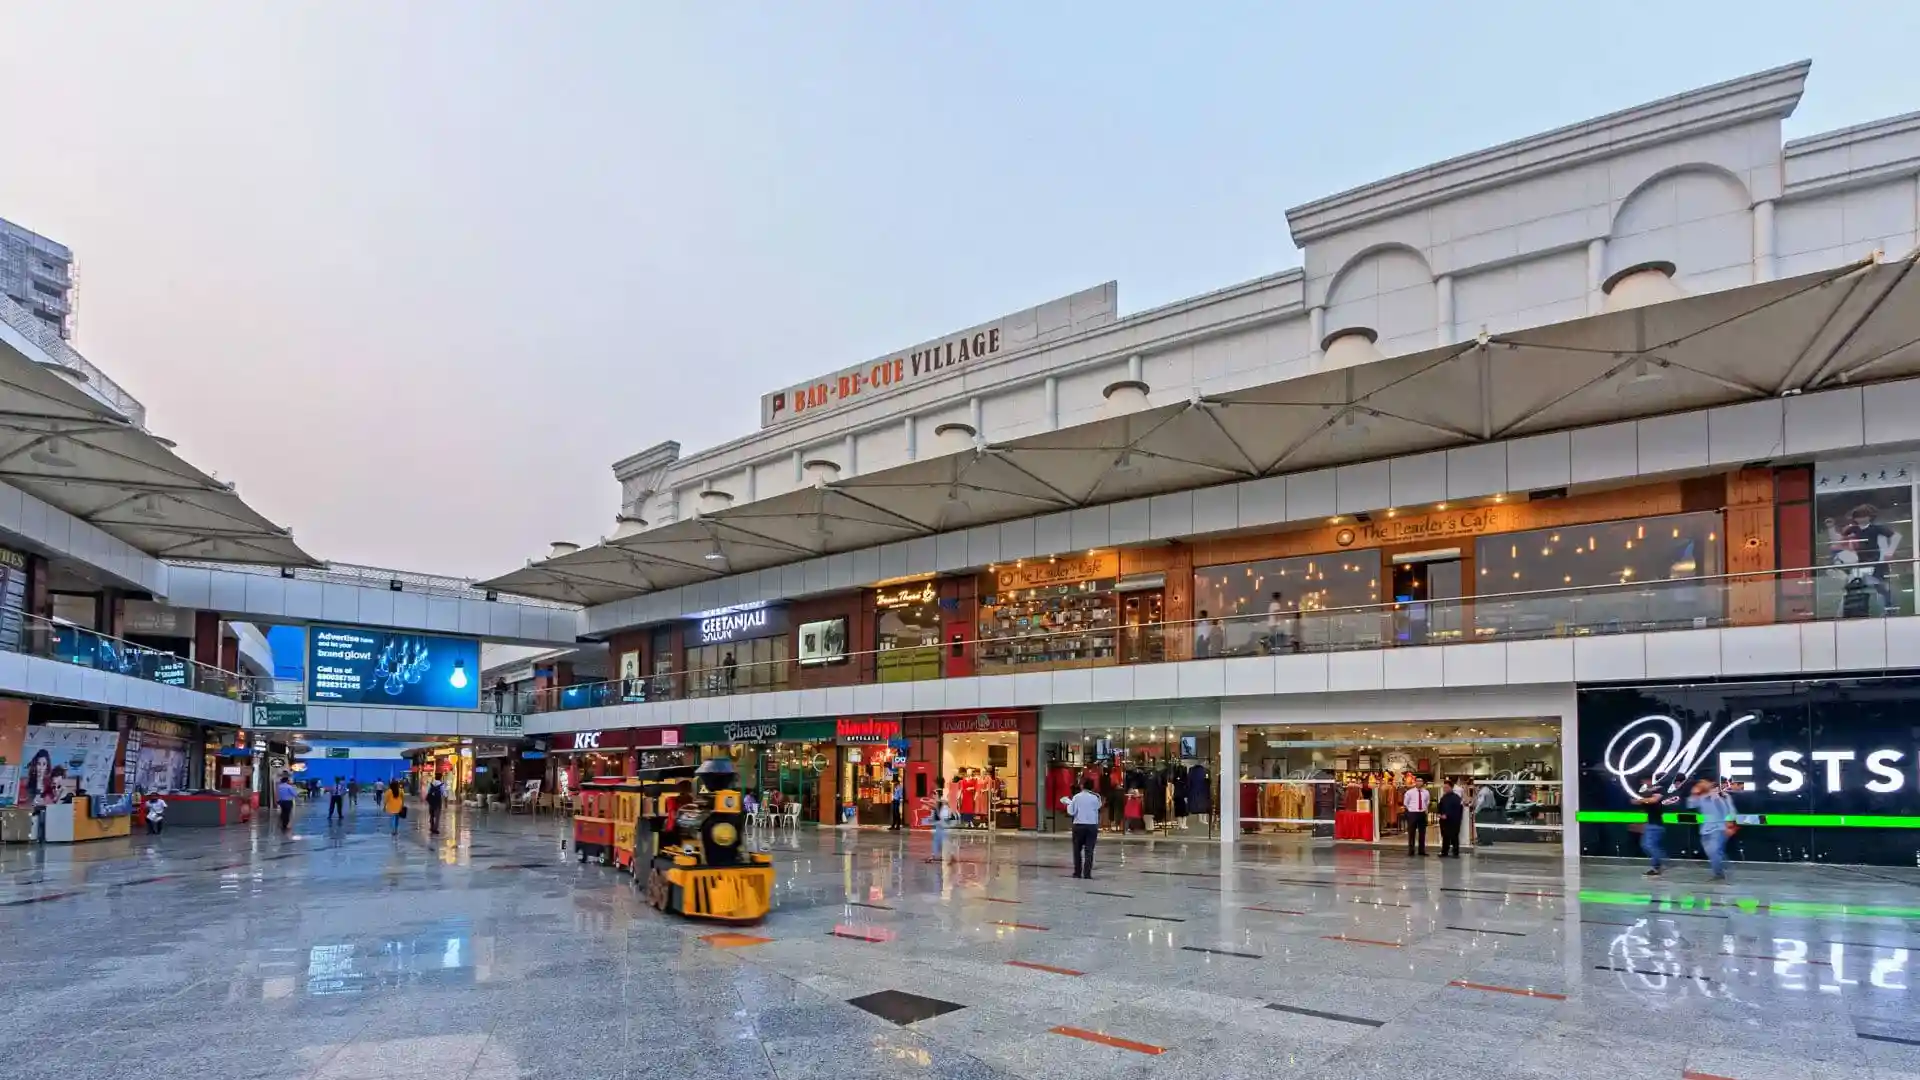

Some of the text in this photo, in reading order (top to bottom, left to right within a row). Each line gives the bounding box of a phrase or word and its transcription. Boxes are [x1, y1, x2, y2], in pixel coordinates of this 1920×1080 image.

[794, 328, 1000, 412] BAR-BE-CUE VILLAGE
[1360, 522, 1389, 540] The
[1393, 514, 1457, 537] Reader's
[702, 610, 765, 634] GEETANJALI
[702, 629, 733, 643] SALON
[345, 651, 372, 660] glow!
[574, 731, 601, 749] KFC
[723, 723, 777, 741] Chaayos
[1604, 714, 1920, 801] WESTS
